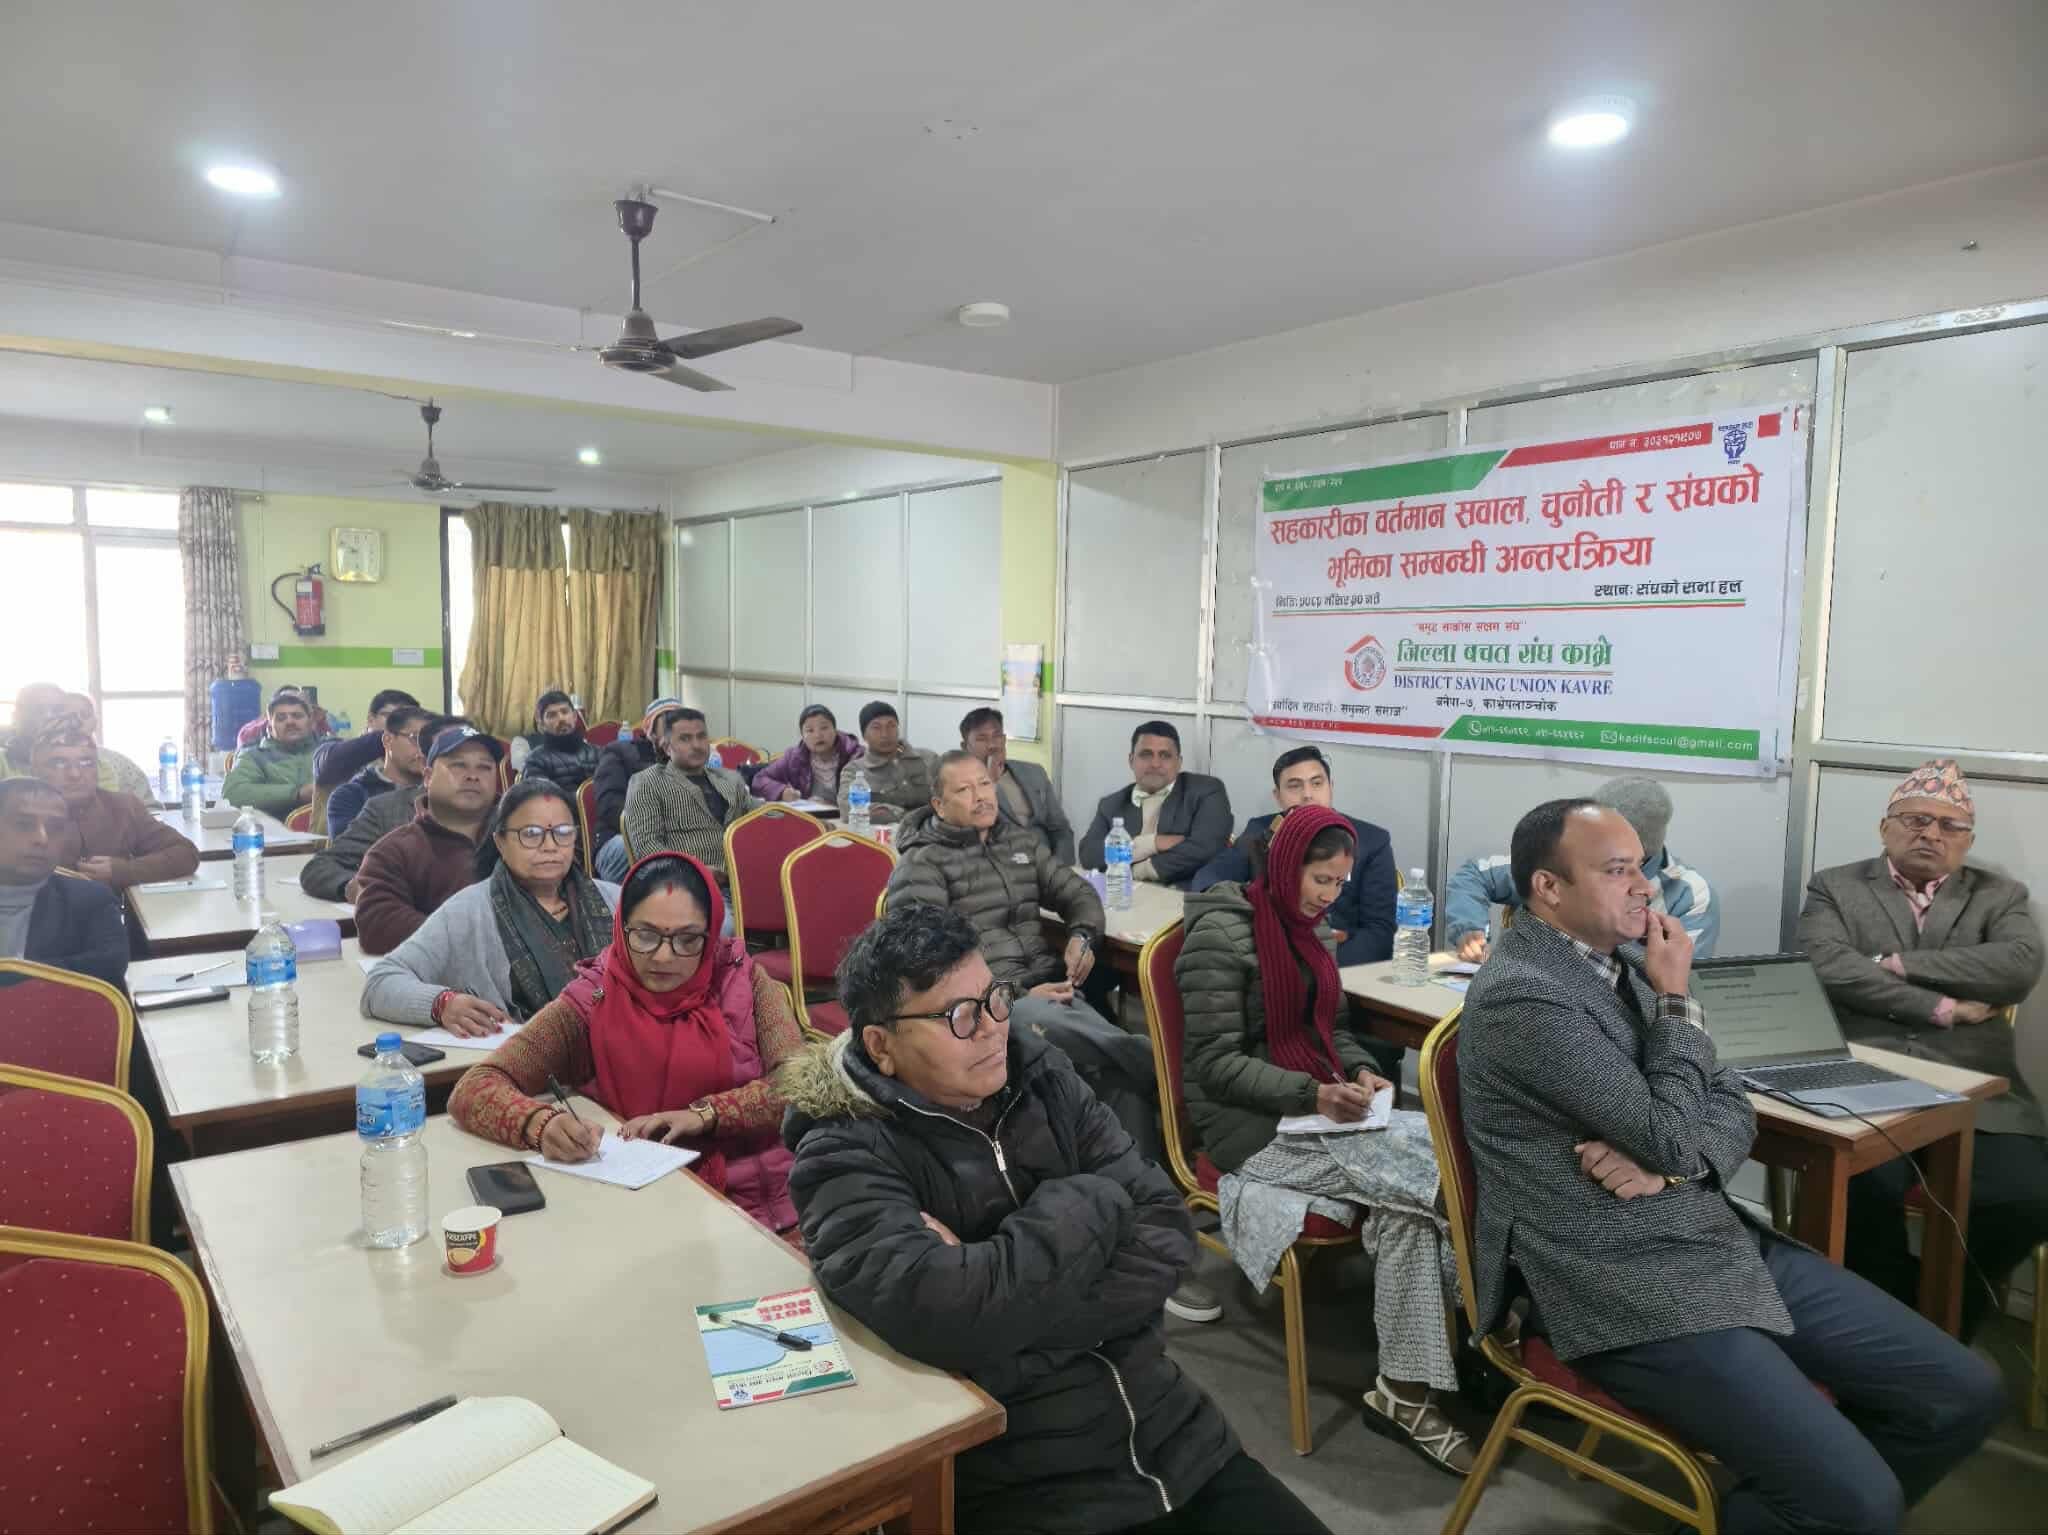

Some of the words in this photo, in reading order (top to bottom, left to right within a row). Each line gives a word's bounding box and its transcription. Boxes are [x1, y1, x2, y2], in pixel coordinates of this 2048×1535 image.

[1270, 507, 1369, 544] सहकारीका
[1376, 501, 1447, 534] वर्तमान
[1455, 496, 1530, 529] सवाल,
[1540, 478, 1627, 528] चुनौती
[1635, 482, 1657, 513] र
[1665, 464, 1763, 512] संघको
[1328, 548, 1393, 588] भूमिका
[1400, 539, 1488, 579] सम्बन्धी
[1496, 531, 1656, 573] अन्तरक्रिया
[1636, 579, 1680, 596] संघको
[1682, 579, 1715, 595] सभा
[1718, 579, 1744, 594] हल
[1397, 638, 1457, 664] जिल्ला
[1463, 643, 1511, 664] बचत
[1518, 636, 1554, 664] संघ
[1560, 634, 1614, 667] काभ्रे
[1394, 675, 1452, 690] DISTRICT
[1455, 676, 1507, 692] SAVING
[1509, 678, 1557, 693] UNION
[1559, 679, 1613, 696] KAVRE
